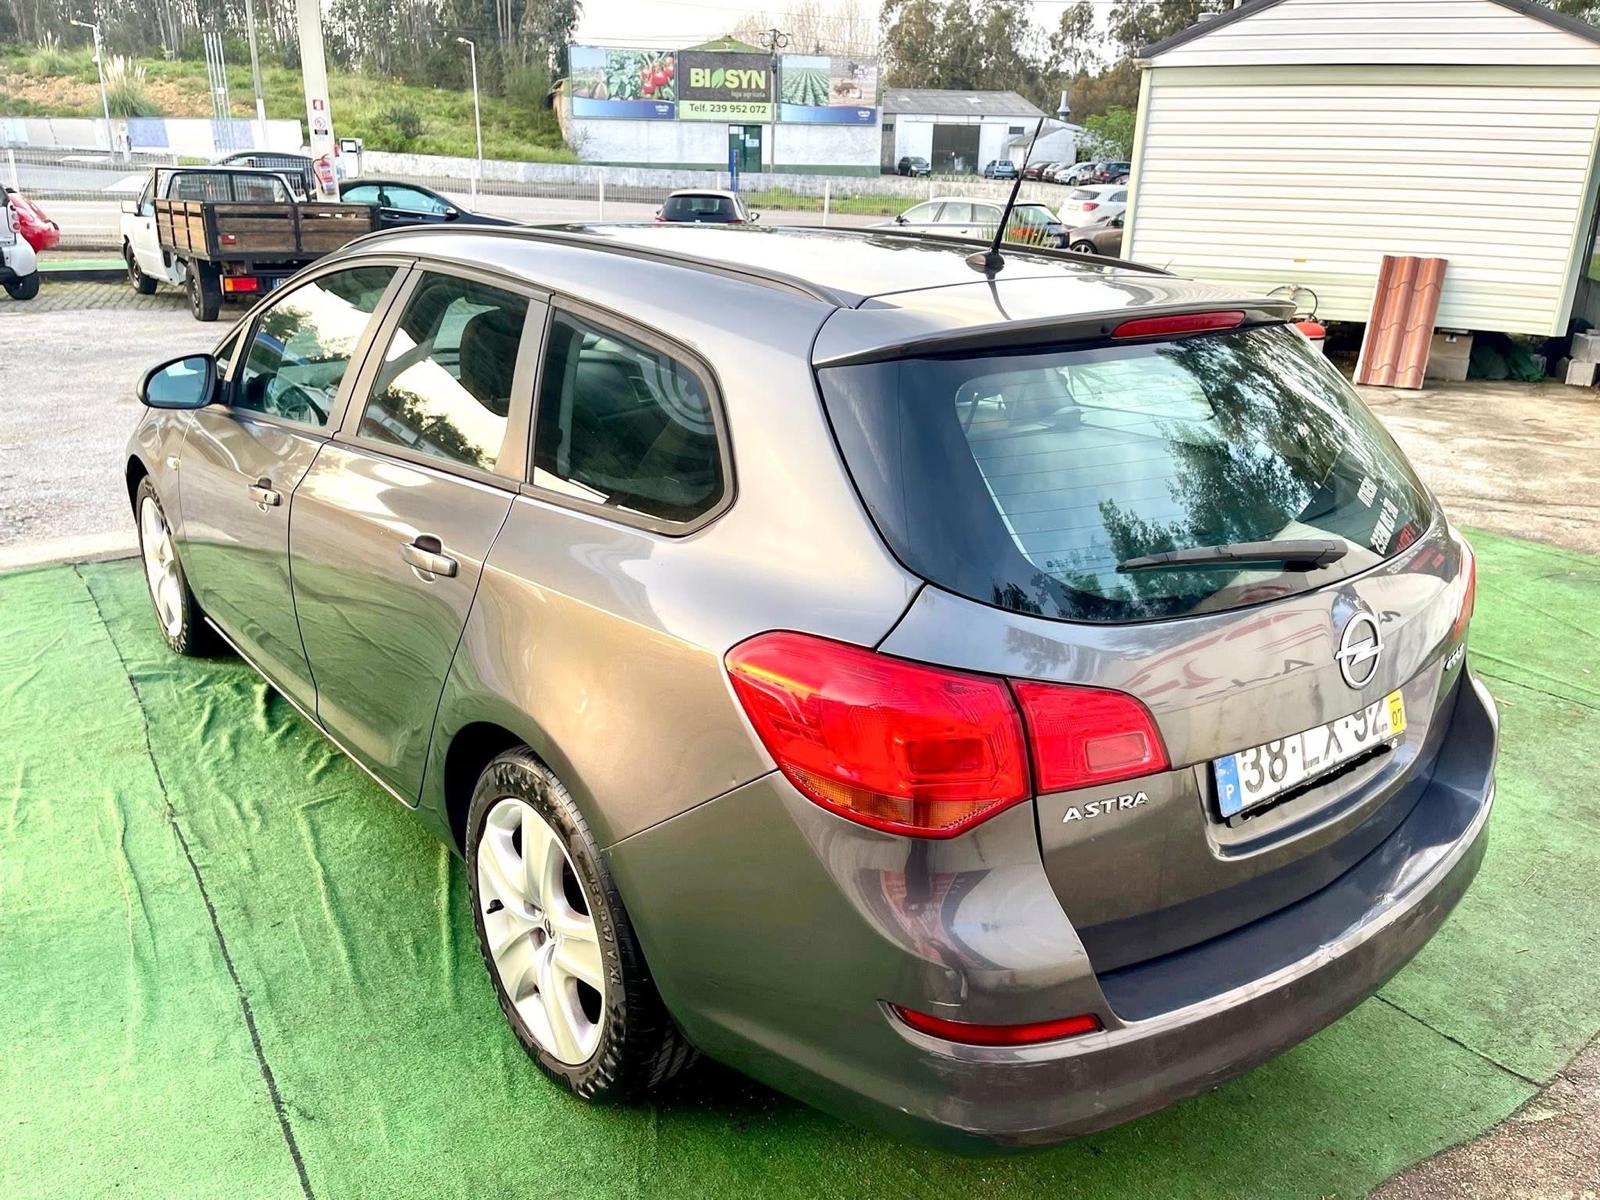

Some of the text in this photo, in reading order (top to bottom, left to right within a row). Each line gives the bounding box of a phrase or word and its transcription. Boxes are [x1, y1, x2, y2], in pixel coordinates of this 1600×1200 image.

[690, 67, 766, 89] BIOSYN
[689, 103, 767, 114] Telf. 239 952 072
[1225, 785, 1235, 798] P
[1391, 707, 1403, 727] 07
[1062, 791, 1150, 823] ASTRA
